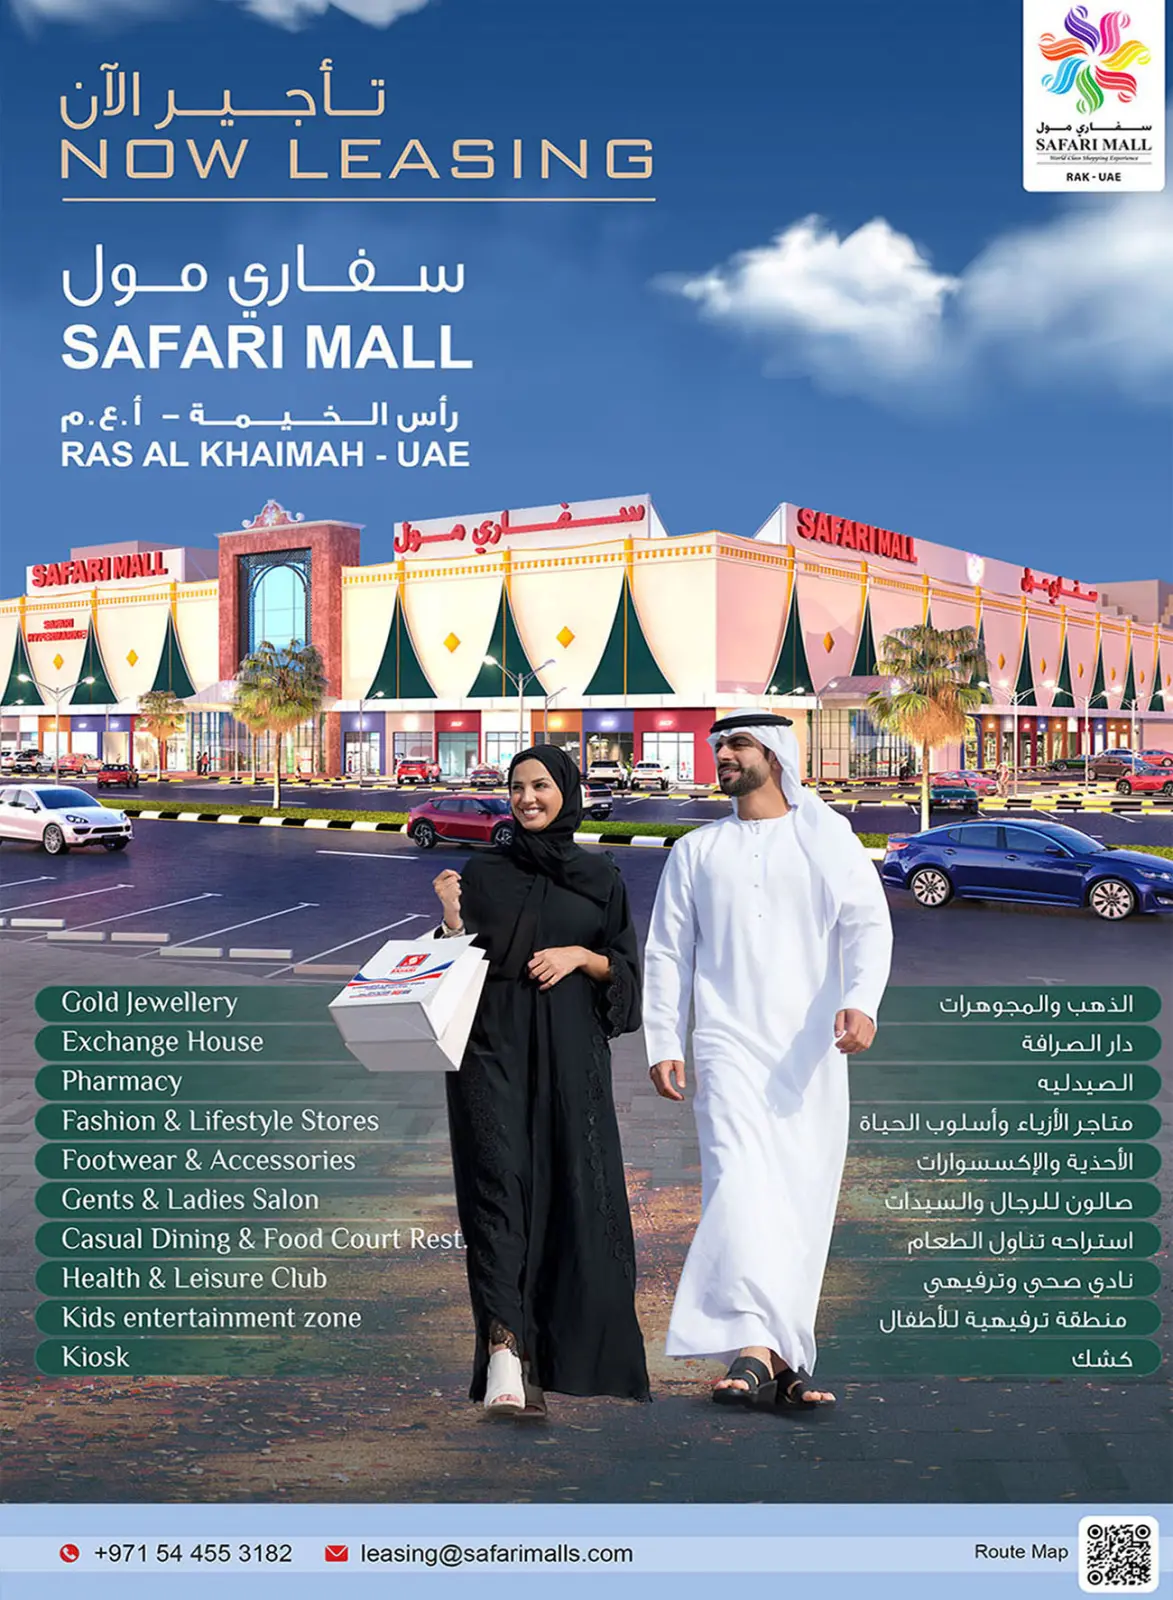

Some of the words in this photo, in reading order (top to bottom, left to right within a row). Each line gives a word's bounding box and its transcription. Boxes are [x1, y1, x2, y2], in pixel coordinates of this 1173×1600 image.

[60, 63, 141, 130] الآن
[1035, 138, 1098, 152] SAFARI
[1102, 138, 1153, 152] MALL
[61, 139, 249, 179] NOW
[289, 139, 653, 179] LEASING
[1066, 172, 1090, 182] RAK
[1098, 172, 1122, 182] UAE
[62, 324, 283, 370] SAFARI
[306, 325, 473, 369] MALL
[397, 396, 459, 434] رأس
[62, 441, 133, 467] RAS
[143, 441, 189, 467] AL
[201, 441, 364, 467] KHAIMAH
[398, 441, 470, 467] UAE
[796, 507, 876, 554] SAFARI
[877, 527, 918, 565] MALL
[31, 557, 112, 588] SAFARI
[113, 551, 169, 580] MALL
[62, 990, 119, 1013] Gold
[126, 990, 239, 1018] Jewellery
[939, 994, 1061, 1018] والمجوهرات
[1067, 994, 1134, 1017] الذهب
[63, 1030, 180, 1057] Exchange
[188, 1030, 264, 1052] House
[1021, 1034, 1102, 1057] الصرافة
[1106, 1034, 1134, 1057] دار
[63, 1070, 183, 1097] Pharmacy
[63, 1109, 156, 1131] Fashion
[164, 1109, 181, 1132] &
[190, 1109, 294, 1137] Lifestyle
[301, 1109, 380, 1132] Stores
[859, 1113, 920, 1136] الحياة
[926, 1108, 1009, 1137] وأسلوب
[1016, 1108, 1069, 1136] الأزياء
[1073, 1113, 1134, 1136] متاجر
[63, 1149, 178, 1170] Footwear
[185, 1148, 203, 1171] &
[210, 1148, 356, 1171] Accessories
[916, 1152, 1061, 1176] والإكسسوارات
[1066, 1147, 1134, 1174] الأحذية
[62, 1188, 133, 1210] Gents
[142, 1187, 159, 1210] &
[167, 1188, 246, 1210] Ladies
[252, 1187, 320, 1210] Salon
[884, 1191, 984, 1214] والسيدات
[990, 1191, 1060, 1215] للرجال
[1065, 1191, 1134, 1215] صالون
[62, 1227, 143, 1249] Casual
[152, 1228, 231, 1255] Dining
[238, 1227, 255, 1250] &
[264, 1227, 324, 1249] Food
[331, 1227, 401, 1250] Court
[409, 1227, 468, 1250] Rest.
[907, 1231, 983, 1255] الطعام
[988, 1231, 1046, 1255] تناول
[63, 1267, 140, 1289] Health
[149, 1266, 166, 1289] &
[174, 1267, 264, 1289] Leisure
[271, 1266, 327, 1289] Club
[923, 1271, 1017, 1298] وترفيهي
[1023, 1277, 1082, 1298] صحي
[1087, 1271, 1134, 1298] نادي
[63, 1306, 116, 1328] Kids
[123, 1307, 296, 1328] entertainment
[303, 1311, 362, 1328] zone
[879, 1304, 960, 1334] للأطفال
[965, 1311, 1050, 1333] ترفيهية
[1055, 1311, 1128, 1329] منطقة
[63, 1346, 130, 1368] Kiosk
[1071, 1348, 1134, 1368] كشك
[94, 1544, 147, 1563] +971
[156, 1544, 183, 1563] 54
[190, 1544, 231, 1563] 455
[238, 1544, 292, 1563] 3182
[361, 1544, 633, 1567] leasing@safarimalls.com
[974, 1544, 1026, 1559] Route
[1032, 1543, 1069, 1562] Map
